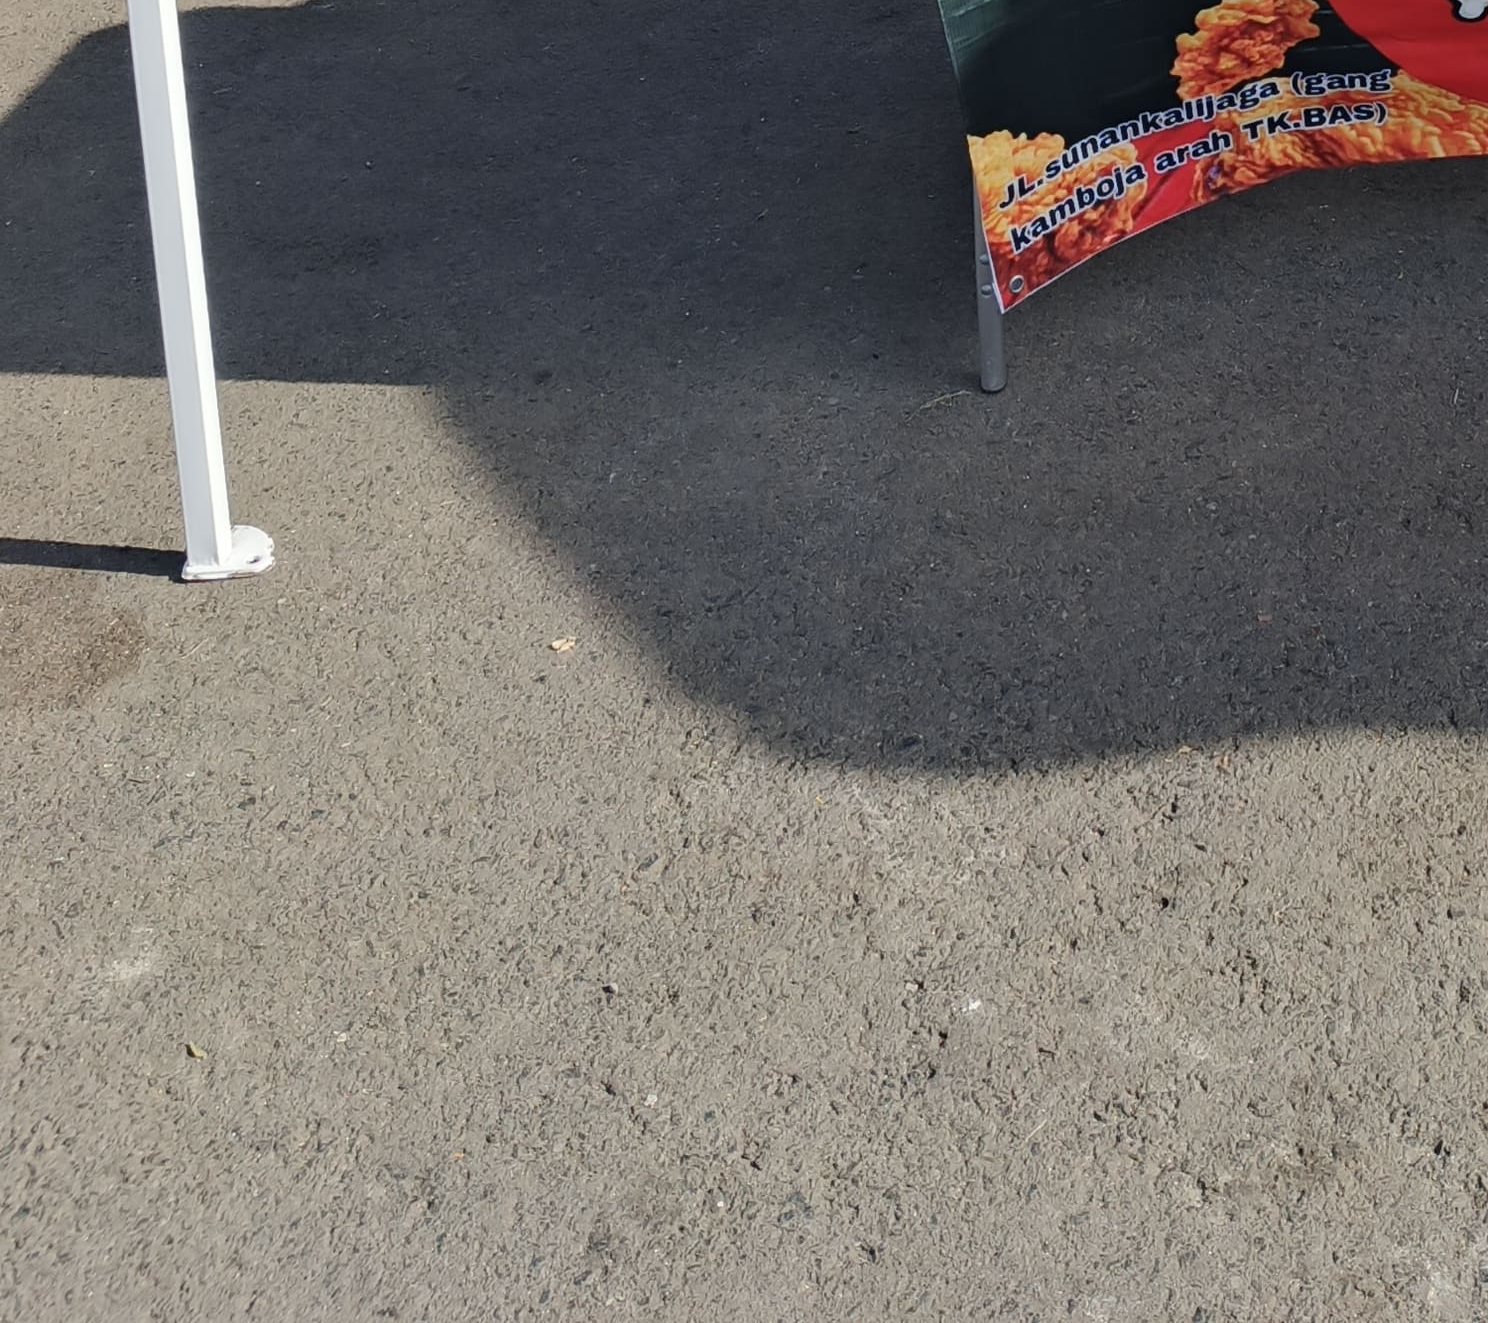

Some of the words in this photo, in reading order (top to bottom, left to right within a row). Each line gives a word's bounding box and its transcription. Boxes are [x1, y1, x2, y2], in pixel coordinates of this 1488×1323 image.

[1290, 69, 1393, 97] (gang
[1009, 163, 1147, 255] kamboja
[1154, 130, 1232, 174] arah
[1241, 102, 1389, 142] TK.BAS)
